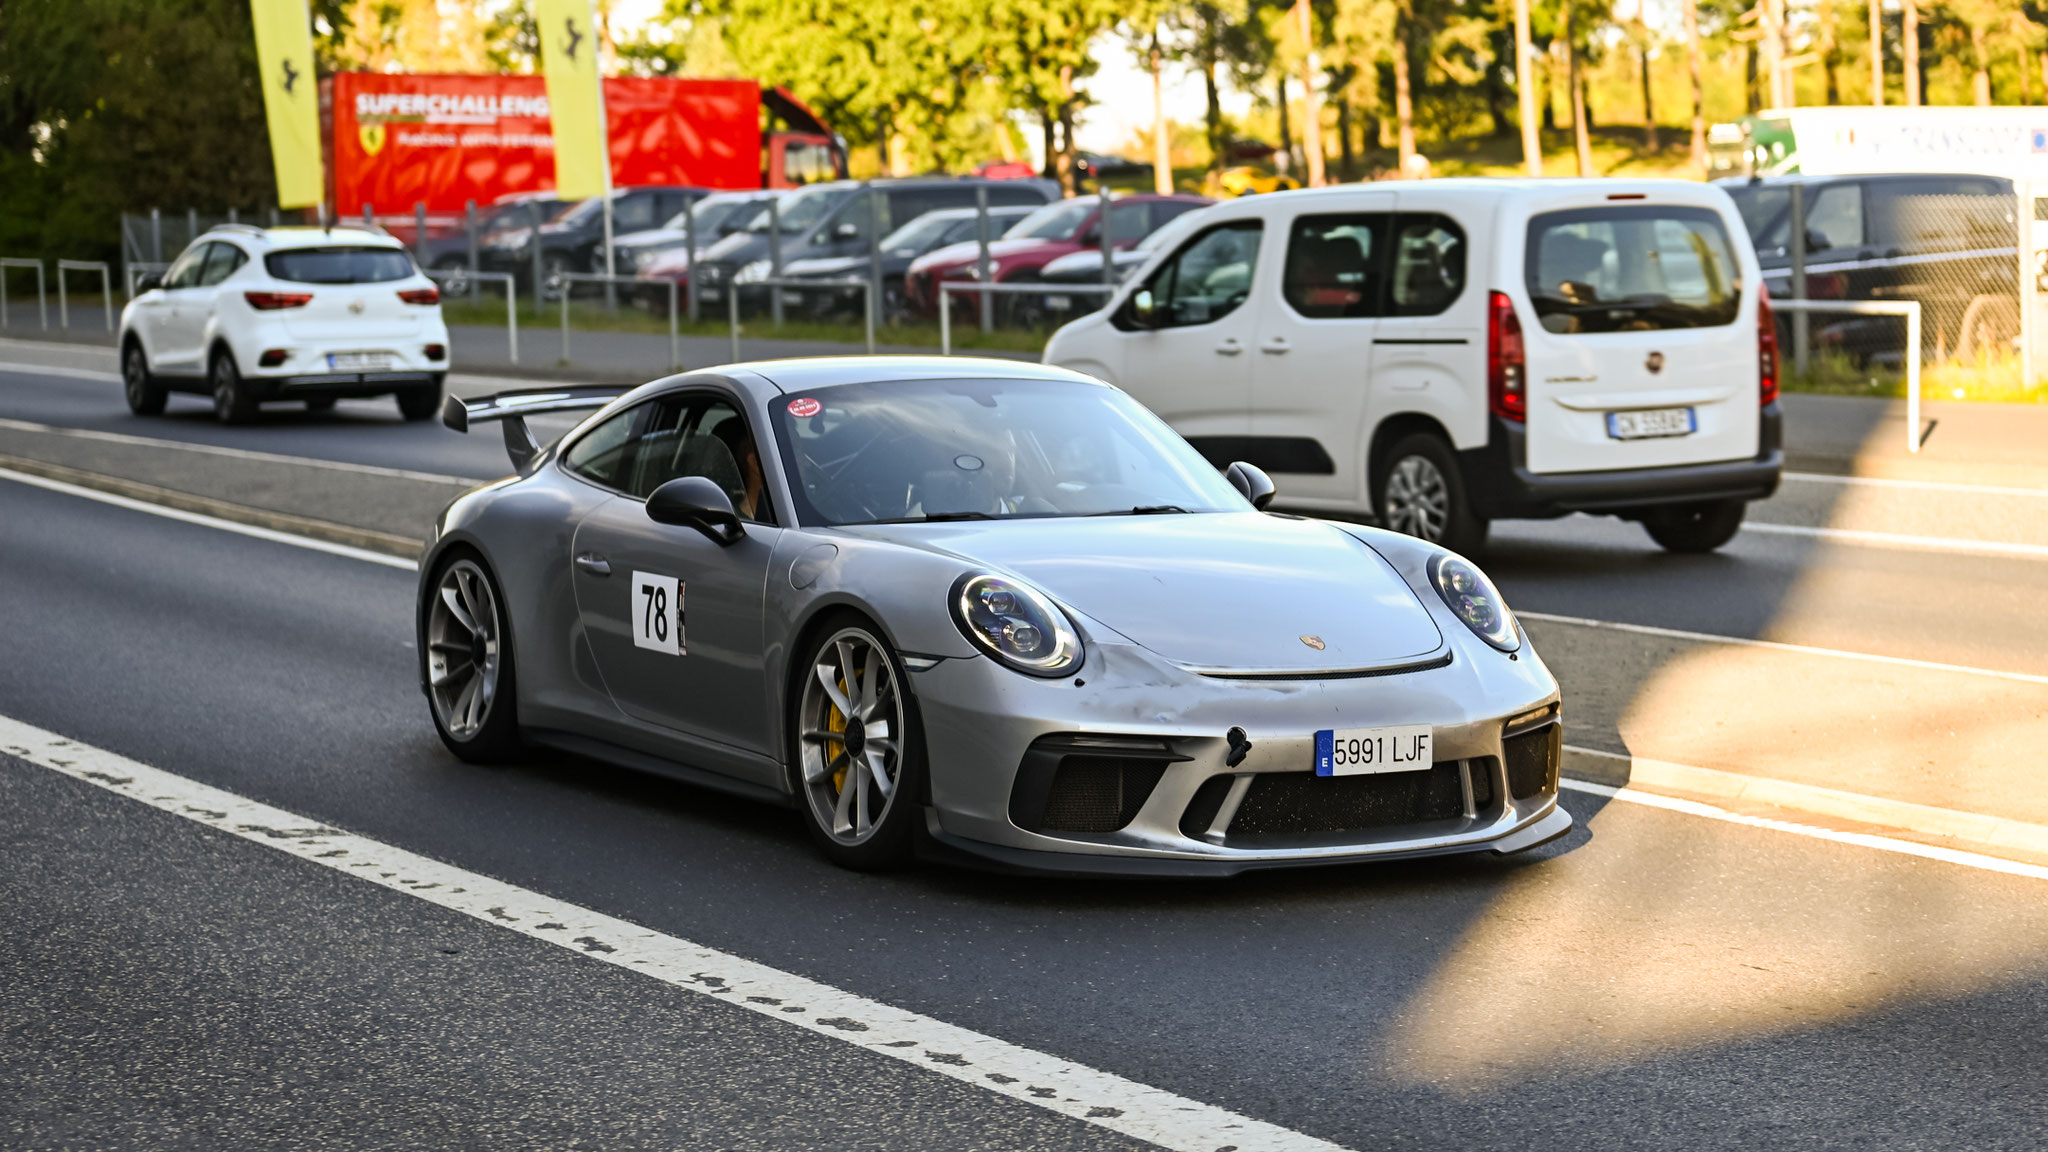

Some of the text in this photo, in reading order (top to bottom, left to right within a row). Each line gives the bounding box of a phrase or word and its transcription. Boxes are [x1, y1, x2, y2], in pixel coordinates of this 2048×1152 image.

[356, 93, 549, 117] SUPERCHALLENG
[642, 584, 667, 642] 78
[1322, 757, 1329, 768] E
[1335, 735, 1429, 765] 5991 LJF
